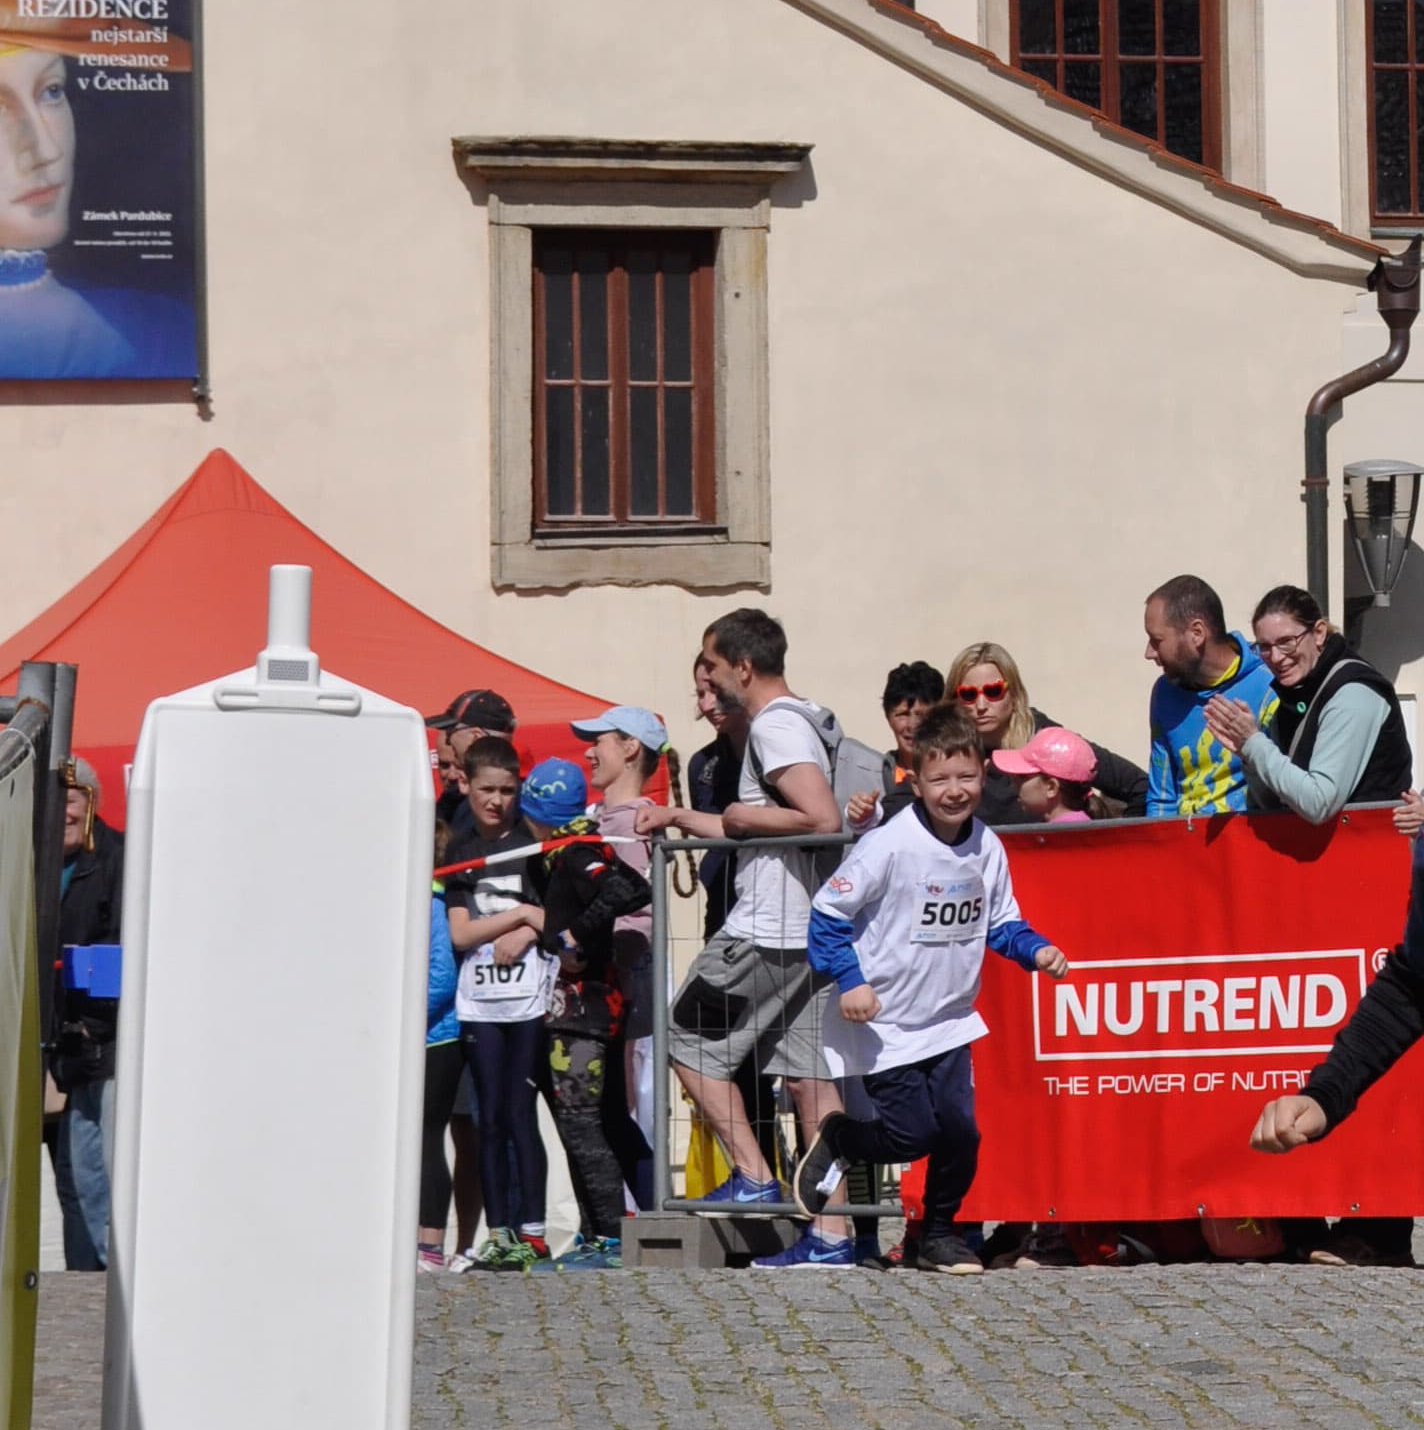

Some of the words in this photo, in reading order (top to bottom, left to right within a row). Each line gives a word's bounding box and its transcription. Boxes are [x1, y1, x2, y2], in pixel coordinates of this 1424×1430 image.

[91, 26, 168, 46] nejstarší
[78, 53, 169, 67] renesance
[77, 77, 90, 90] v
[93, 70, 169, 91] Čechách
[921, 897, 982, 926] 5005
[475, 962, 526, 985] 5107
[1055, 973, 1347, 1036] NUTREND
[1044, 1075, 1089, 1096] THE
[1098, 1073, 1185, 1095] POWER
[1193, 1072, 1224, 1093] OF
